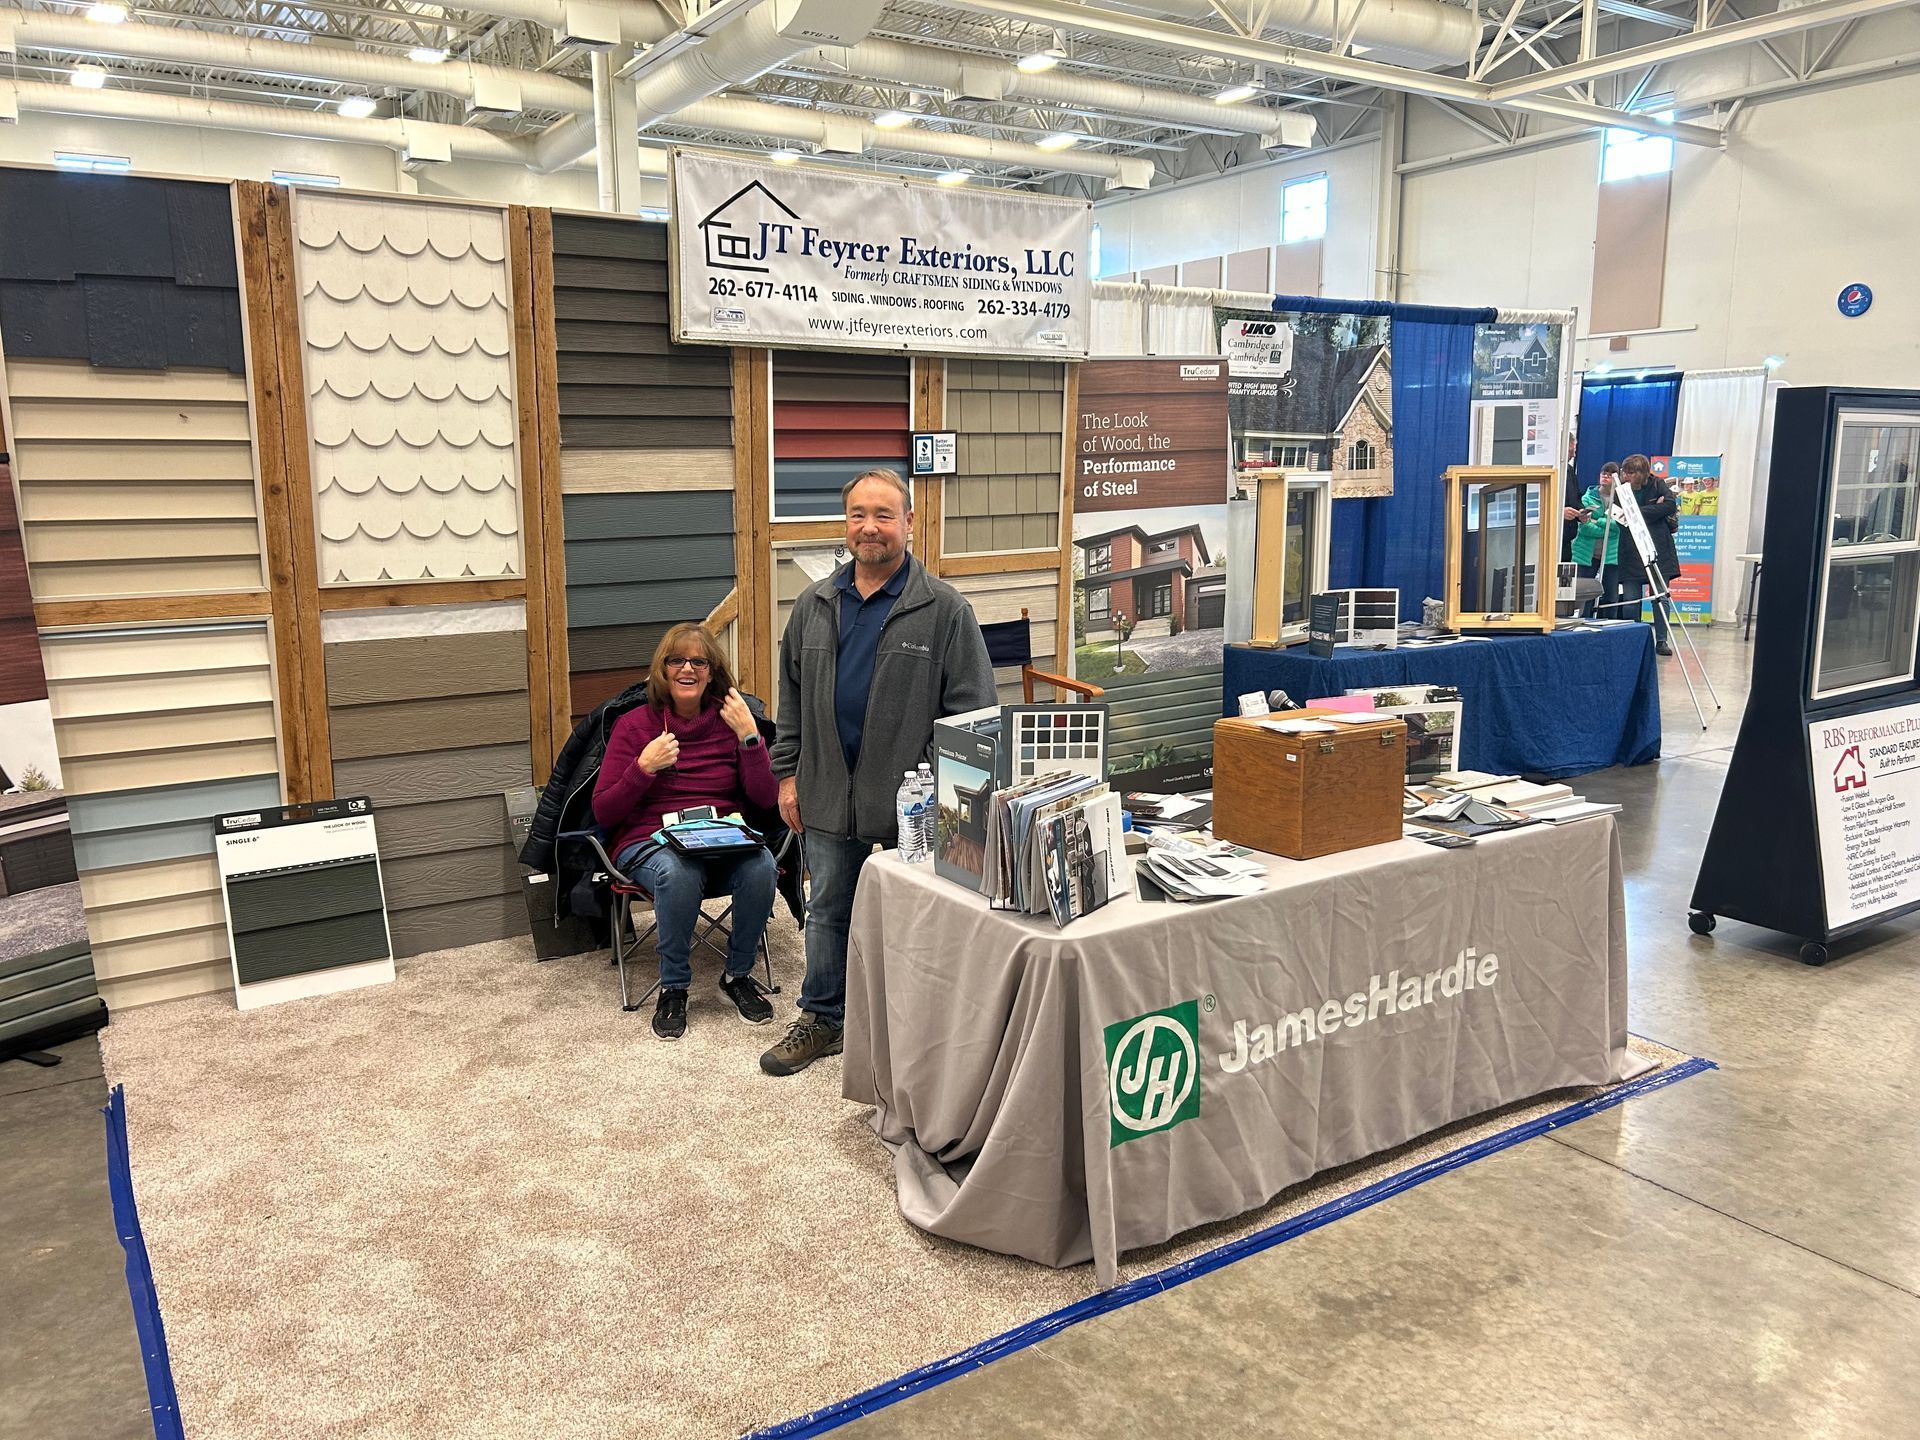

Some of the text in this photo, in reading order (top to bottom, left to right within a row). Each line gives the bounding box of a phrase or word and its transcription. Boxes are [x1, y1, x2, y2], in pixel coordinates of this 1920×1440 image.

[752, 222, 1075, 280] JT Feyrer Exteriors, LLC
[844, 265, 1063, 295] Formerly CRAFTSMEN SIDING & WINDOWS
[708, 277, 818, 302] 262-677-4114
[977, 299, 1071, 319] 262-334-4179
[808, 317, 988, 339] www.jtfeyrerexteriors.com
[1247, 323, 1277, 336] IKO
[1228, 338, 1285, 352] Cambridge and
[1228, 352, 1268, 366] Cambridge
[1243, 382, 1258, 390] HIGH
[1082, 412, 1149, 430] The Look
[1083, 434, 1170, 452] of Wood, the
[1083, 458, 1176, 475] Performance
[1083, 479, 1138, 497] of Steel
[907, 641, 930, 652] Columbia
[1823, 718, 1920, 749] RBS PERFORMANCE PLU
[1869, 743, 1898, 758] STANDARD
[1879, 753, 1916, 769] Built to Perform
[226, 837, 250, 846] SINGLE
[1217, 946, 1500, 1074] JamesHardie
